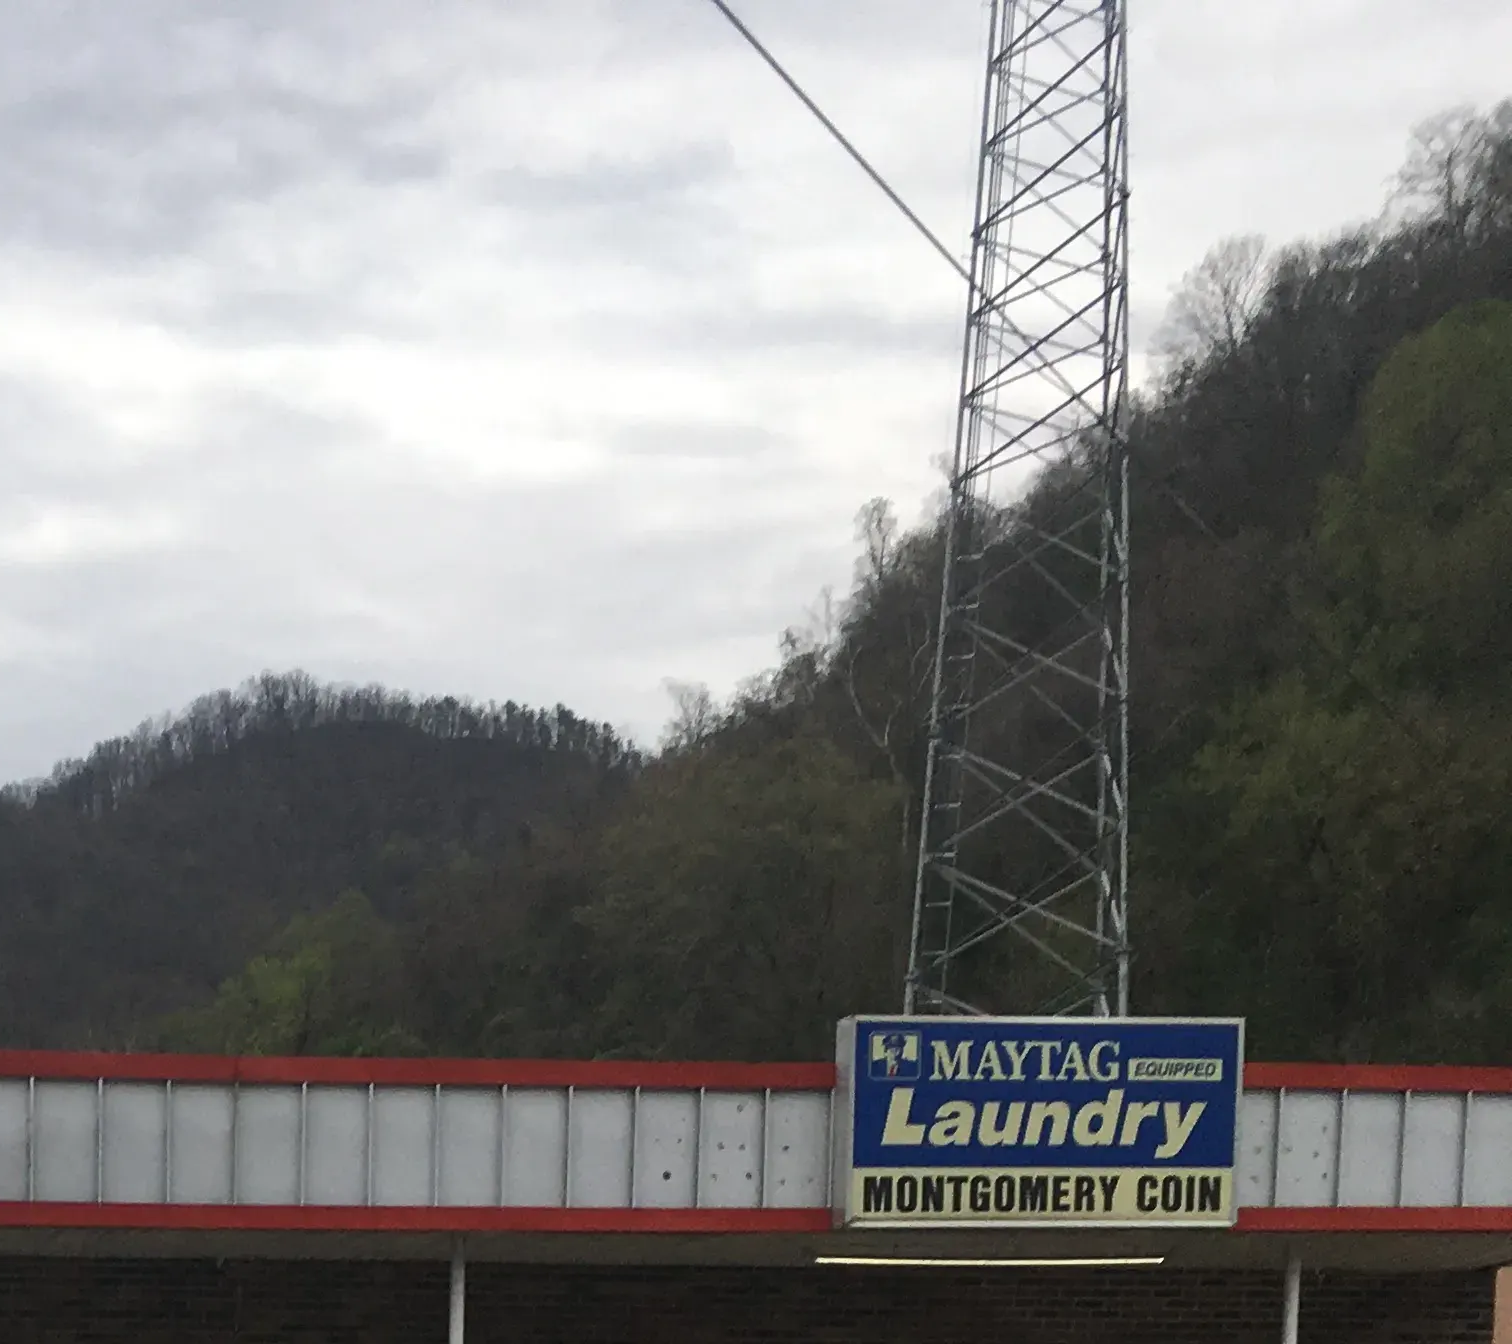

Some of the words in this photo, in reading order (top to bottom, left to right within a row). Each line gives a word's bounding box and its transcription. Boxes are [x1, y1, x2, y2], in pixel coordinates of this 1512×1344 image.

[929, 1040, 1120, 1081] MAYTAG
[1134, 1060, 1217, 1078] EQUIPPED
[881, 1088, 1208, 1159] Laundry
[863, 1175, 1121, 1213] MONTGOMERY
[1136, 1175, 1223, 1212] COIN
